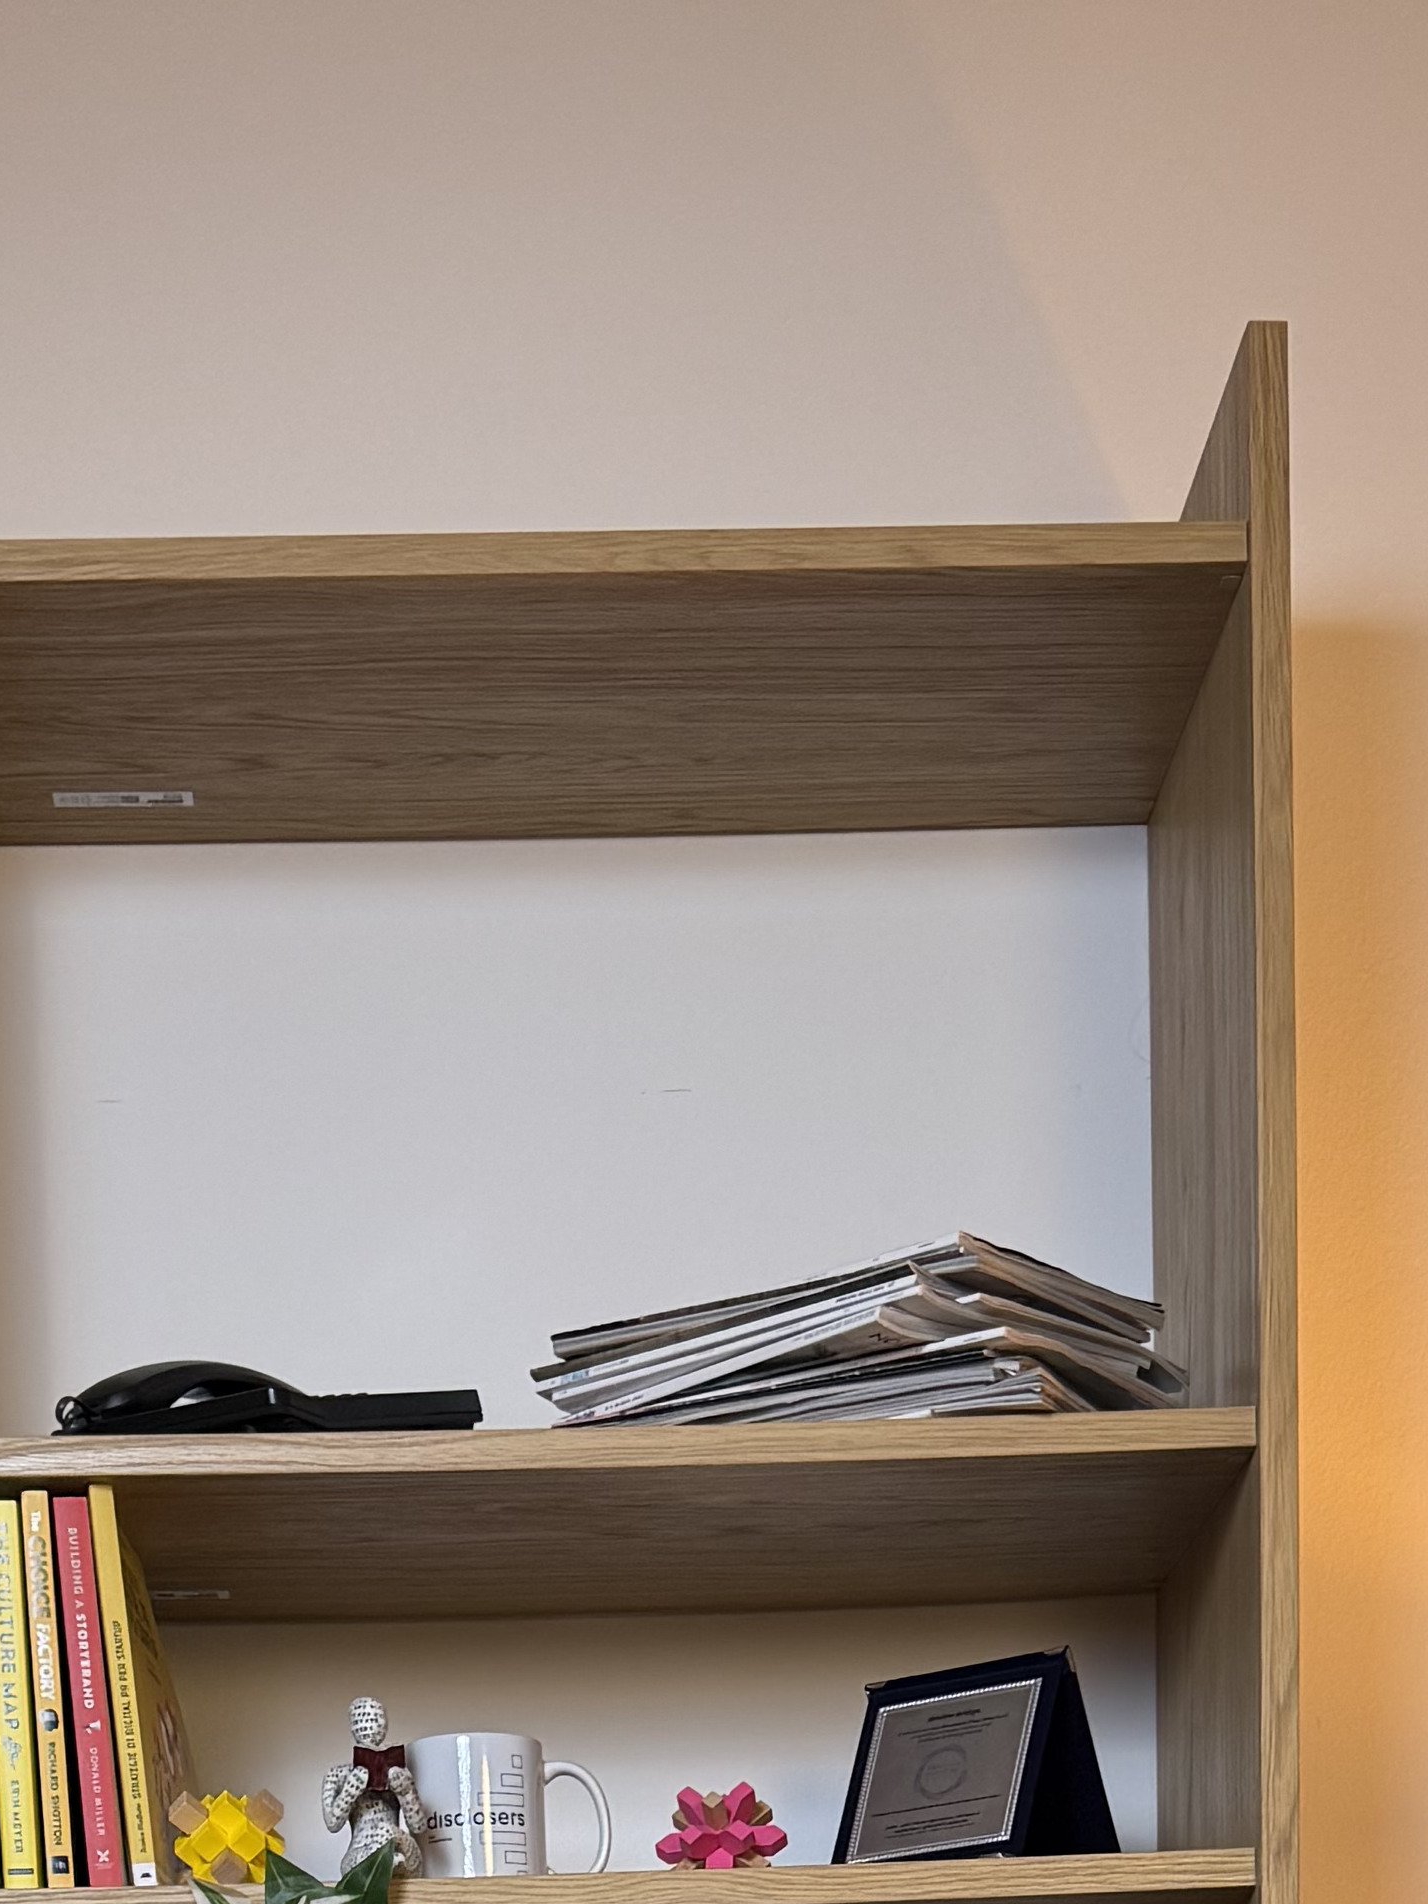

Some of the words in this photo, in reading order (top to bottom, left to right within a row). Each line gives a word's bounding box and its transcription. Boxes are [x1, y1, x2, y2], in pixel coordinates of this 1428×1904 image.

[29, 1510, 42, 1532] The
[27, 1535, 51, 1619] CHOICE
[66, 1526, 86, 1596] BUILDING
[75, 1599, 86, 1609] A
[35, 1622, 56, 1701] FACTORY
[74, 1613, 96, 1709] STORYBRAND
[111, 1620, 125, 1660] STARTUP
[121, 1700, 134, 1736] DIGITAL
[2, 1682, 19, 1730] MAP
[12, 1811, 25, 1854] MEYER
[46, 1741, 59, 1791] RICHARD
[88, 1746, 103, 1793] DONALD
[50, 1794, 62, 1846] SHOTTON
[93, 1797, 107, 1837] MILLER
